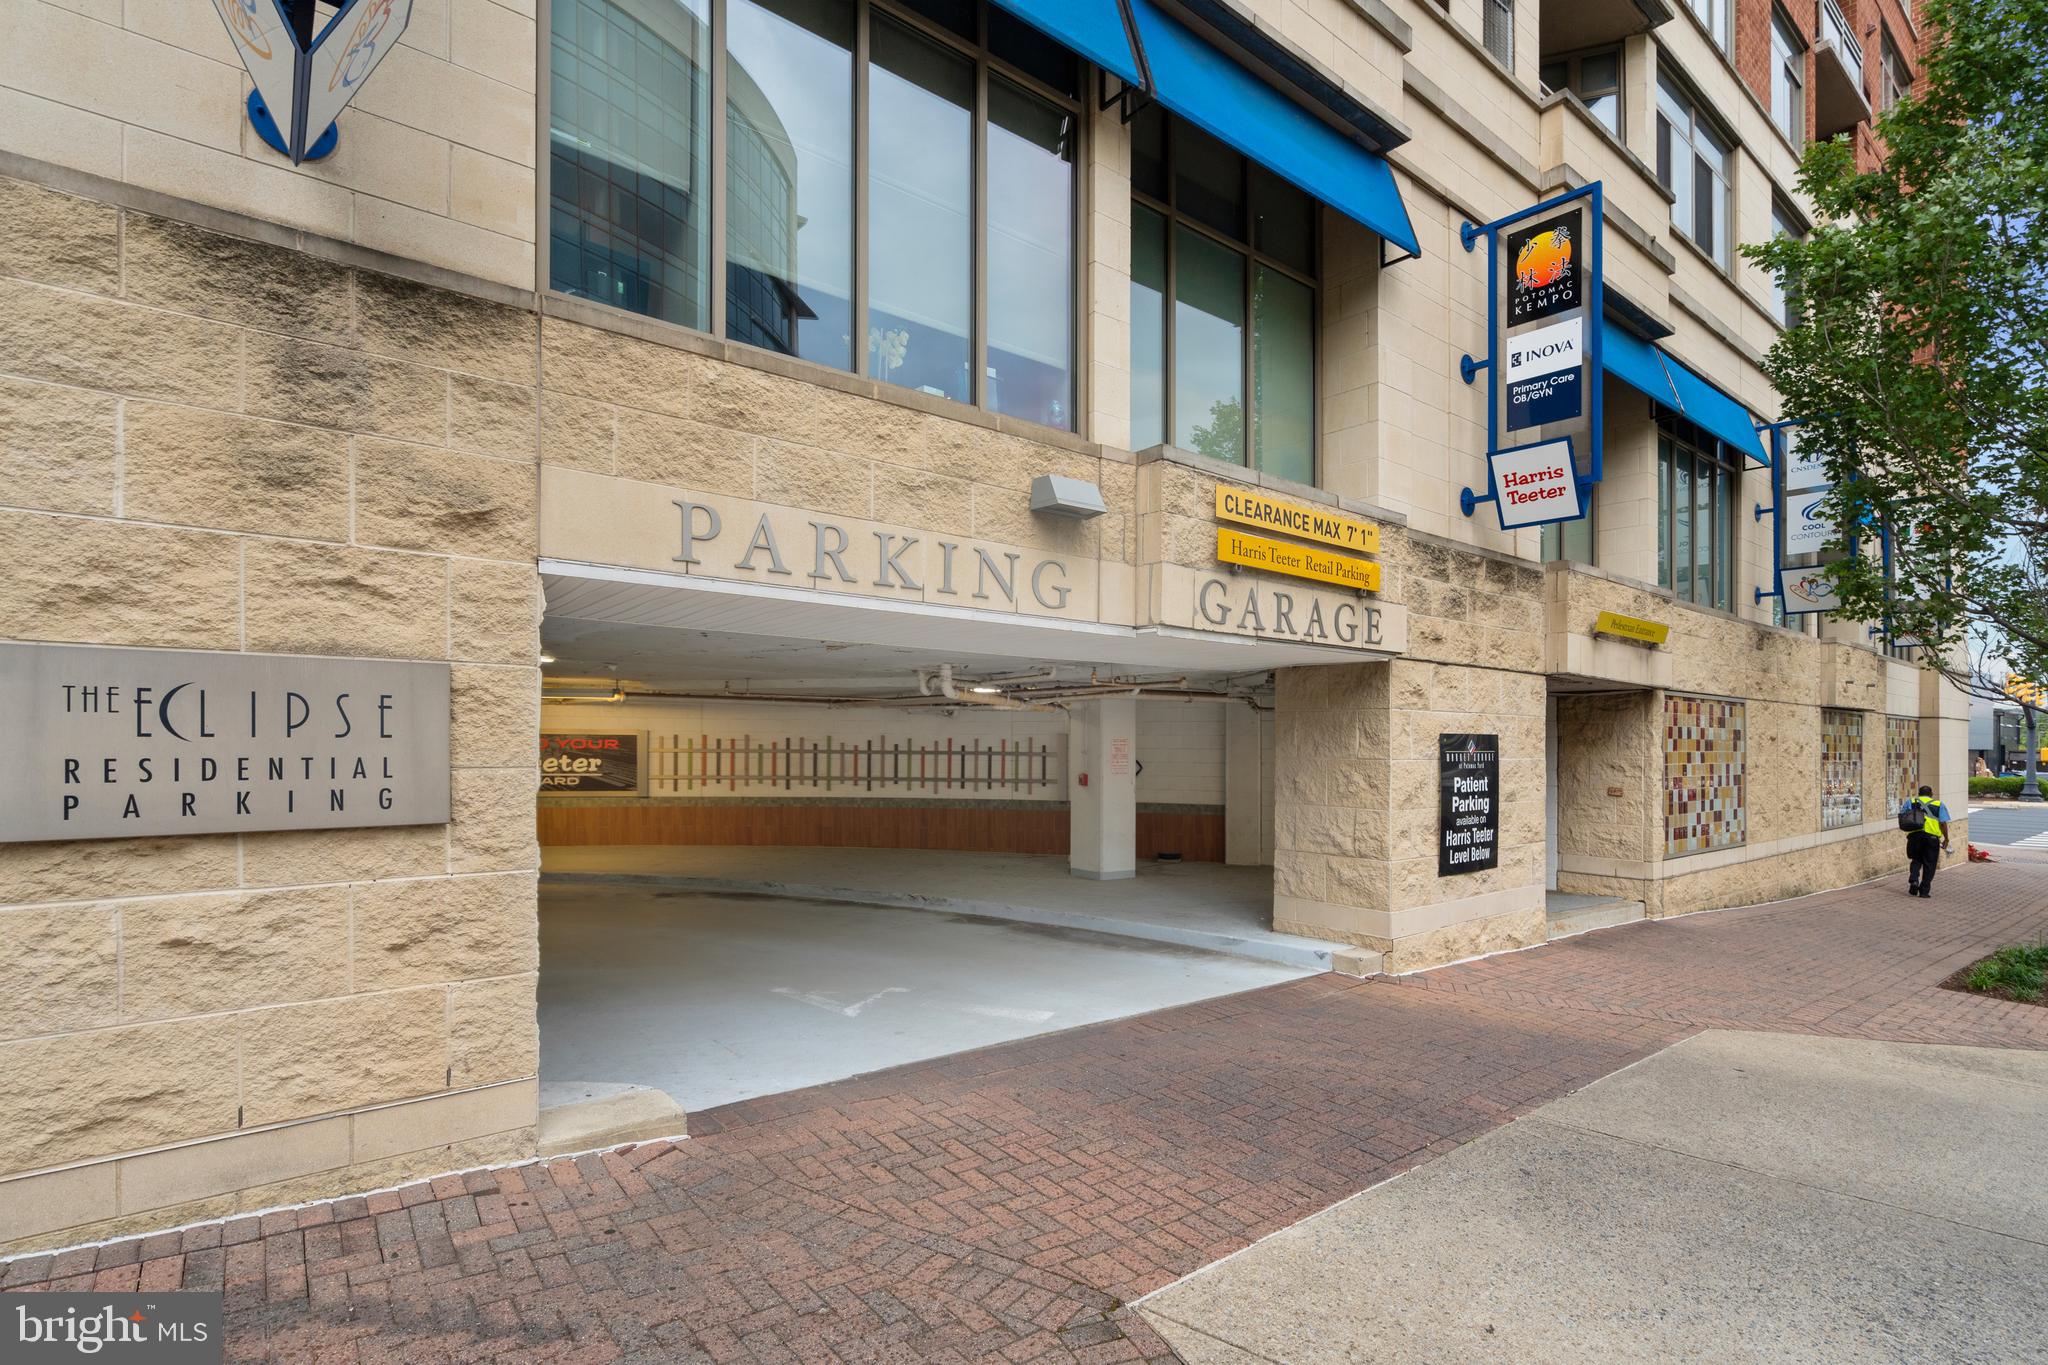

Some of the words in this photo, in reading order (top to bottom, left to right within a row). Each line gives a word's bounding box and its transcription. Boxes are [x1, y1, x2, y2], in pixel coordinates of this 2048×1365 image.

[1515, 280, 1573, 304] POTOMAC
[1515, 290, 1573, 315] KEMPO
[1526, 339, 1574, 362] INOVA
[1513, 380, 1548, 395] Primary
[1550, 373, 1575, 385] Care
[1513, 387, 1553, 404] OB/GYN
[1503, 466, 1564, 488] Harris
[1507, 485, 1567, 505] Teeter
[1224, 494, 1310, 532] CLEARANCE
[1313, 517, 1341, 540] MAX
[1802, 523, 1826, 531] COOL
[671, 500, 1072, 610] PARKING
[1231, 538, 1267, 561] Harris
[1268, 546, 1300, 568] Teeter
[1305, 555, 1334, 575] Retail
[1336, 562, 1371, 587] Parking
[1200, 578, 1384, 645] GARAGE
[61, 685, 120, 713] THE
[133, 682, 394, 742] ECLIPSE
[556, 738, 619, 749] YOUR
[64, 757, 393, 784] RESIDENTIAL
[542, 754, 602, 772] eter
[541, 777, 580, 785] ARD
[1453, 776, 1489, 793] Patient
[63, 788, 393, 820] PARKING
[1452, 795, 1490, 813] Parking
[1456, 815, 1479, 827] available
[1480, 815, 1487, 824] on
[1446, 829, 1472, 847] Harris
[1472, 828, 1494, 844] Teeter
[1449, 849, 1470, 864] Level
[1471, 847, 1490, 862] Below
